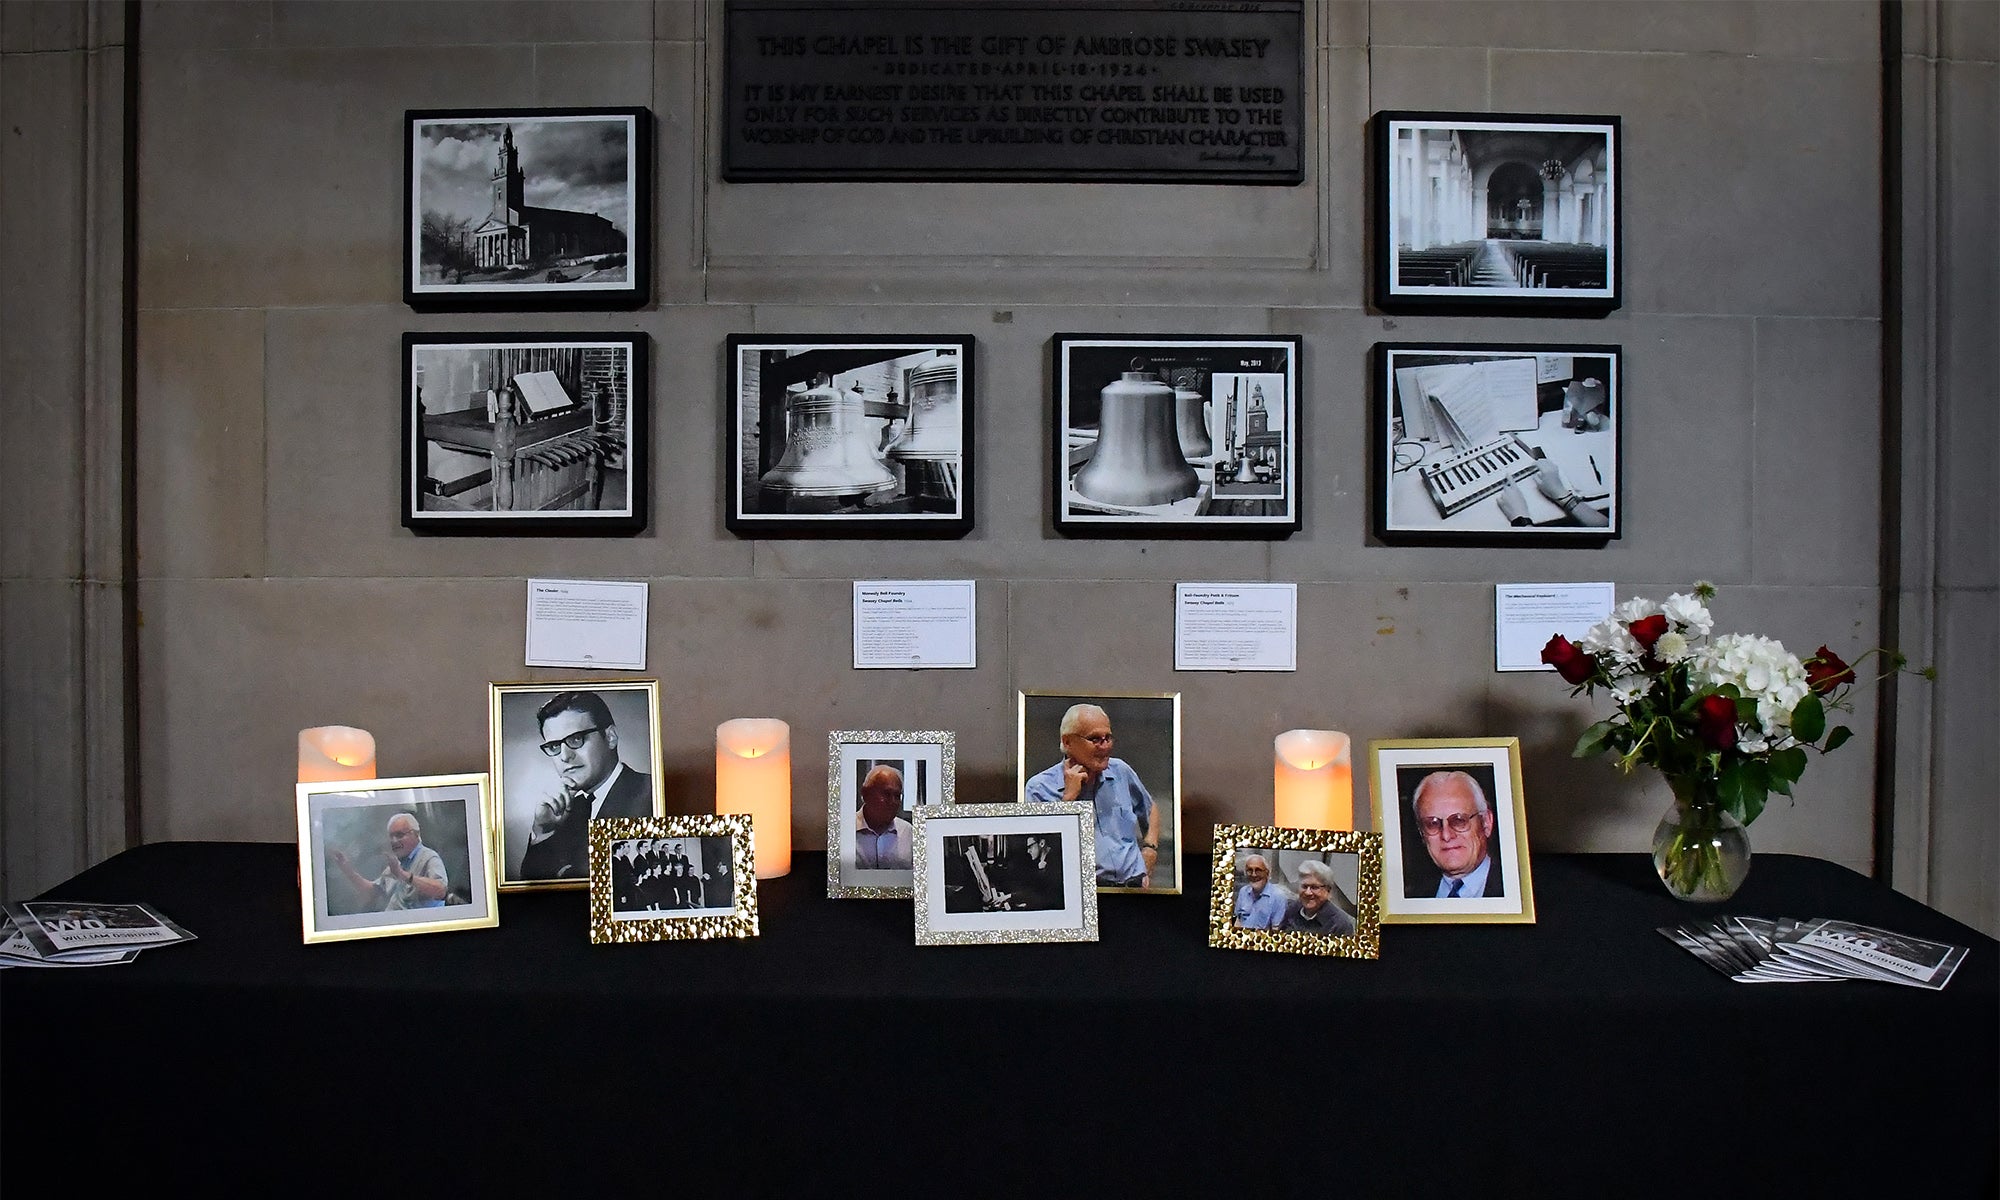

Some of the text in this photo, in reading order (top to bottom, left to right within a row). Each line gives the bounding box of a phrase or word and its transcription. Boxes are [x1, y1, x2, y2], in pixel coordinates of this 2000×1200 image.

[757, 36, 1271, 58] THIS CHAPEL IS THE GIFT OF AMBROSE SWASEY
[744, 85, 1285, 104] IT IS MY EARNEST DESIRE THAT THIS CHAPEL SHALL BE USED
[744, 106, 1283, 126] ONLY FOR SUCH SERVICES AS DIRECTLY CONTRIBUTE TO THE
[742, 127, 1288, 148] WORSHIP OF GOD AND THE UPBUILDING OF CHRISTIAN CHARACTER
[62, 933, 111, 942] WILLIAM
[1814, 938, 1863, 954] WILLIAM
